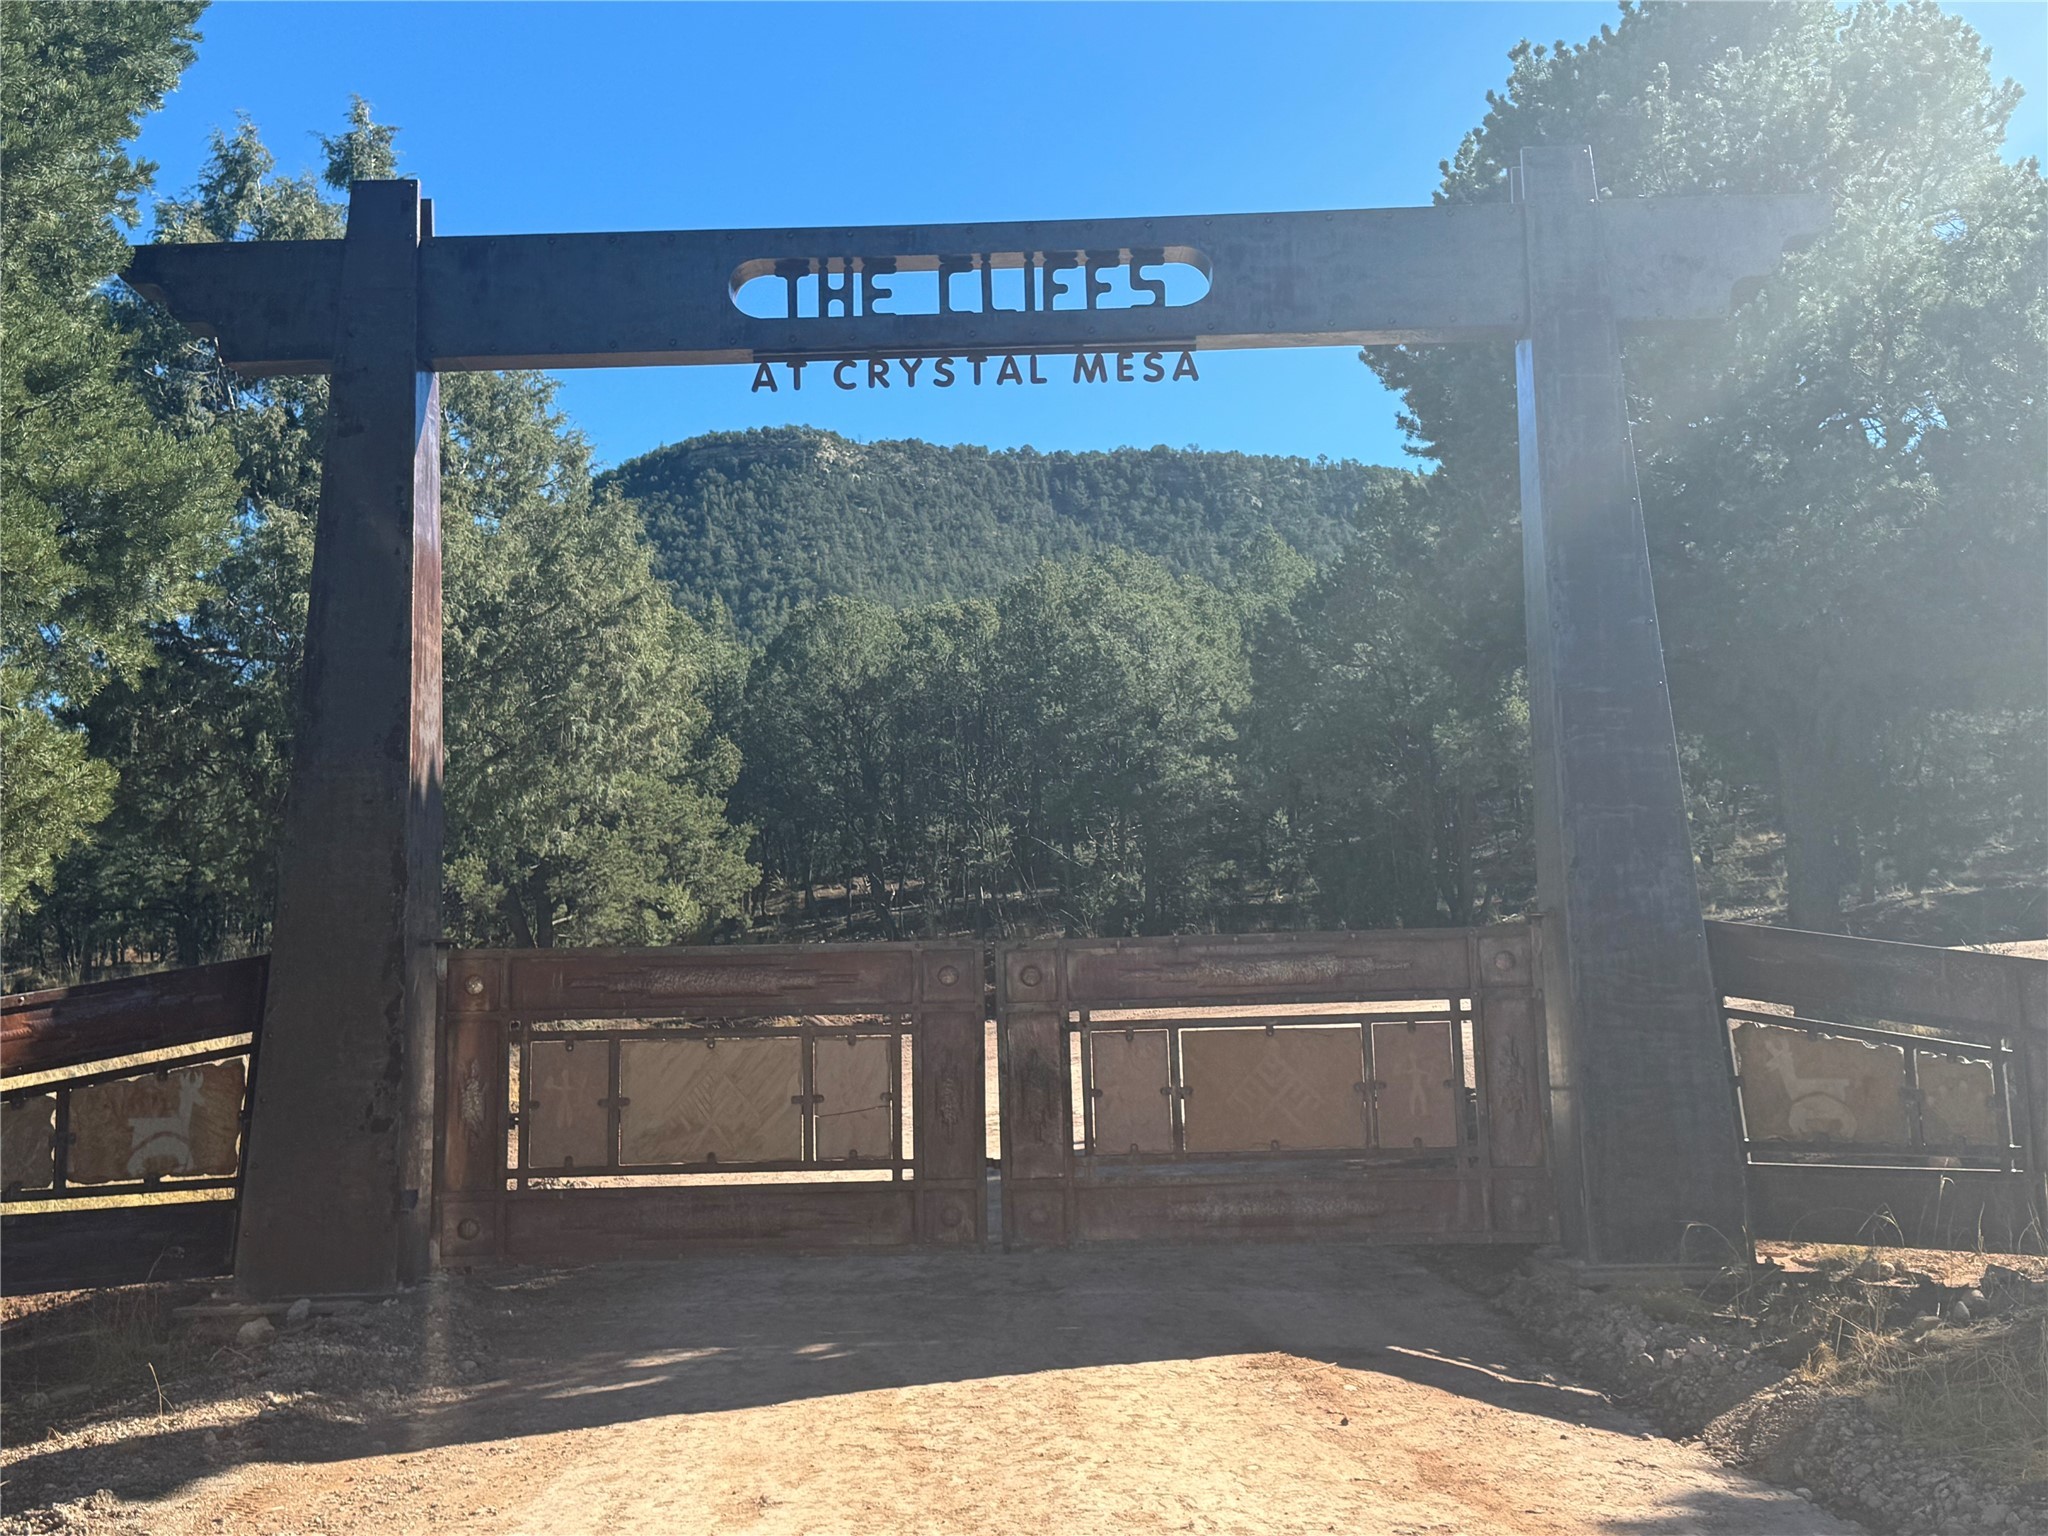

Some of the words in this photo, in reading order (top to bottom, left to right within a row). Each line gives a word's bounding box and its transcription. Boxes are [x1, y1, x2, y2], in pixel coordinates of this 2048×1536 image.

[775, 257, 897, 318] THE
[939, 247, 1166, 314] CLIFFS
[751, 360, 807, 392] AT
[833, 353, 1048, 390] CRYSTAL
[1073, 350, 1199, 384] MESA
